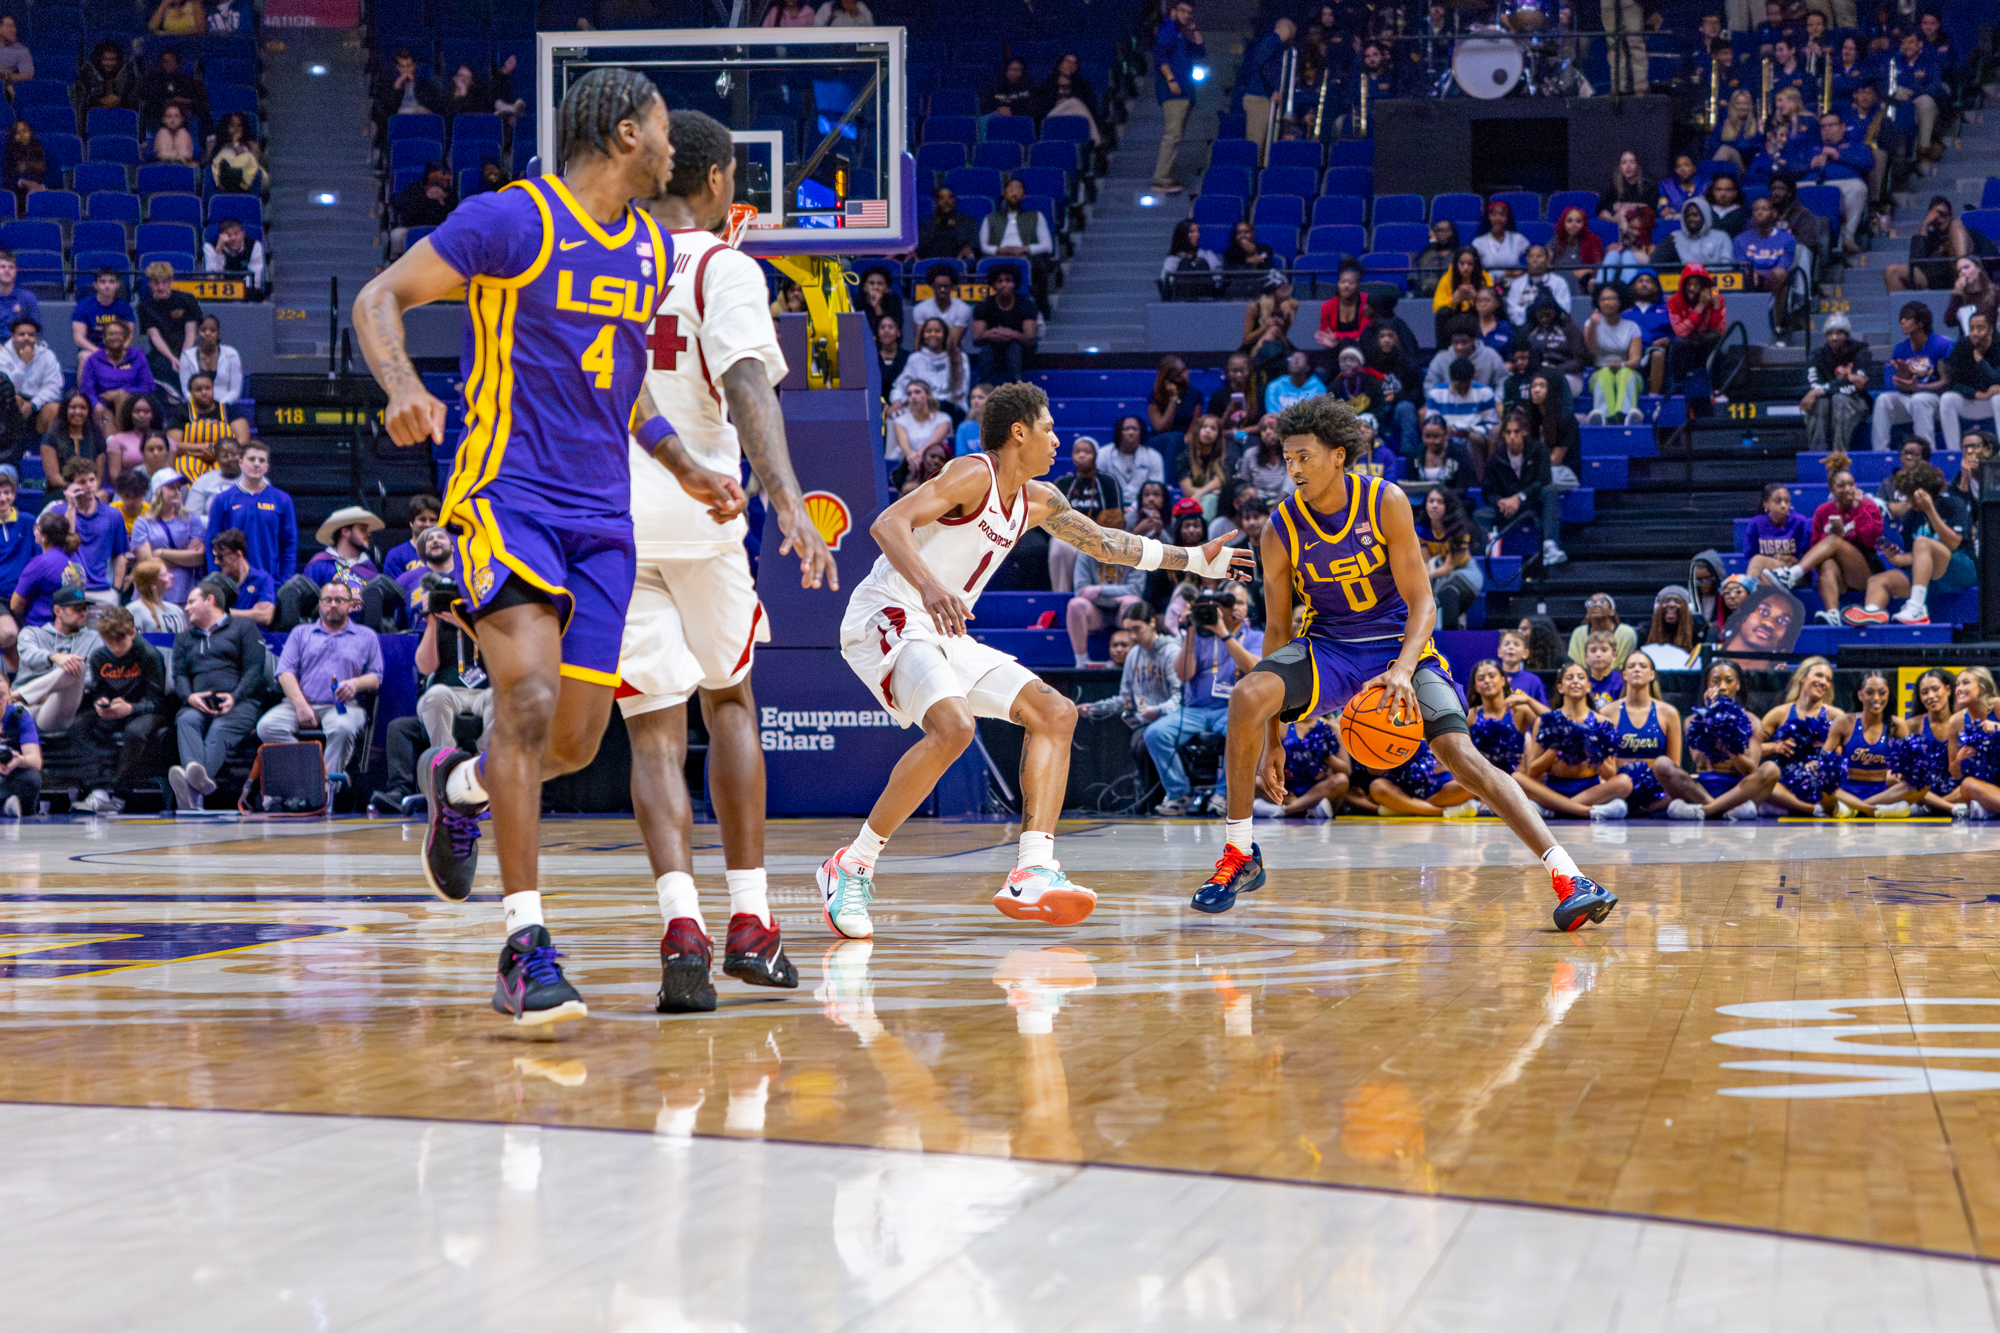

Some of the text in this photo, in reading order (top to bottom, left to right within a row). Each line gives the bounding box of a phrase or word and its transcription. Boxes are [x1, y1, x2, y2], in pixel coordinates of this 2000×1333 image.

[194, 283, 235, 297] 118
[556, 269, 656, 323] LSU
[581, 324, 617, 389] 4
[275, 408, 305, 424] 118
[1758, 538, 1797, 556] TIGERS
[963, 550, 994, 593] 1
[1304, 544, 1387, 582] LSU
[1340, 577, 1378, 613] 0
[761, 730, 835, 751] Share
[1385, 743, 1414, 758] LSU
[1620, 733, 1659, 753] Tigers
[1851, 747, 1887, 766] Tiger
